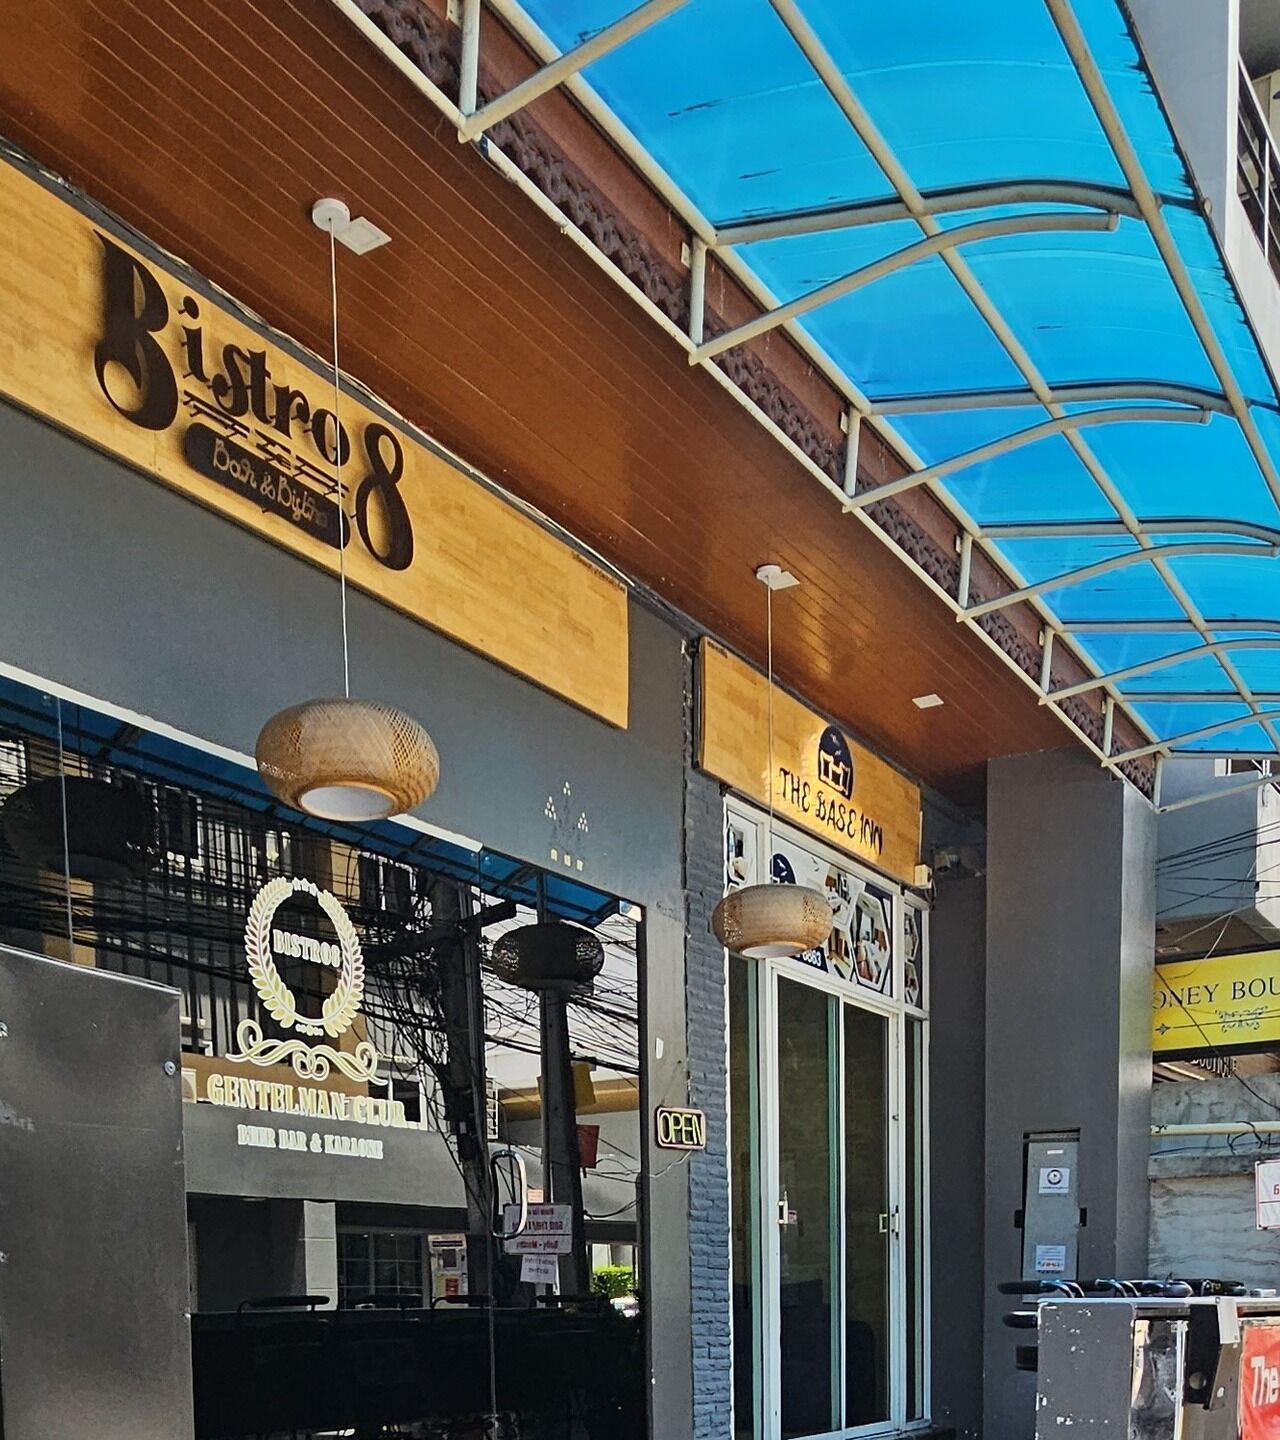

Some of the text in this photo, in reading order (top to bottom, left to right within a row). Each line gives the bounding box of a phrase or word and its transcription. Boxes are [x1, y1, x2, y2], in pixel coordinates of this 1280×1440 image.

[779, 767, 811, 813] THE
[815, 790, 857, 838] BASE
[1152, 983, 1220, 1010] ONEY
[660, 1112, 704, 1145] OPEN
